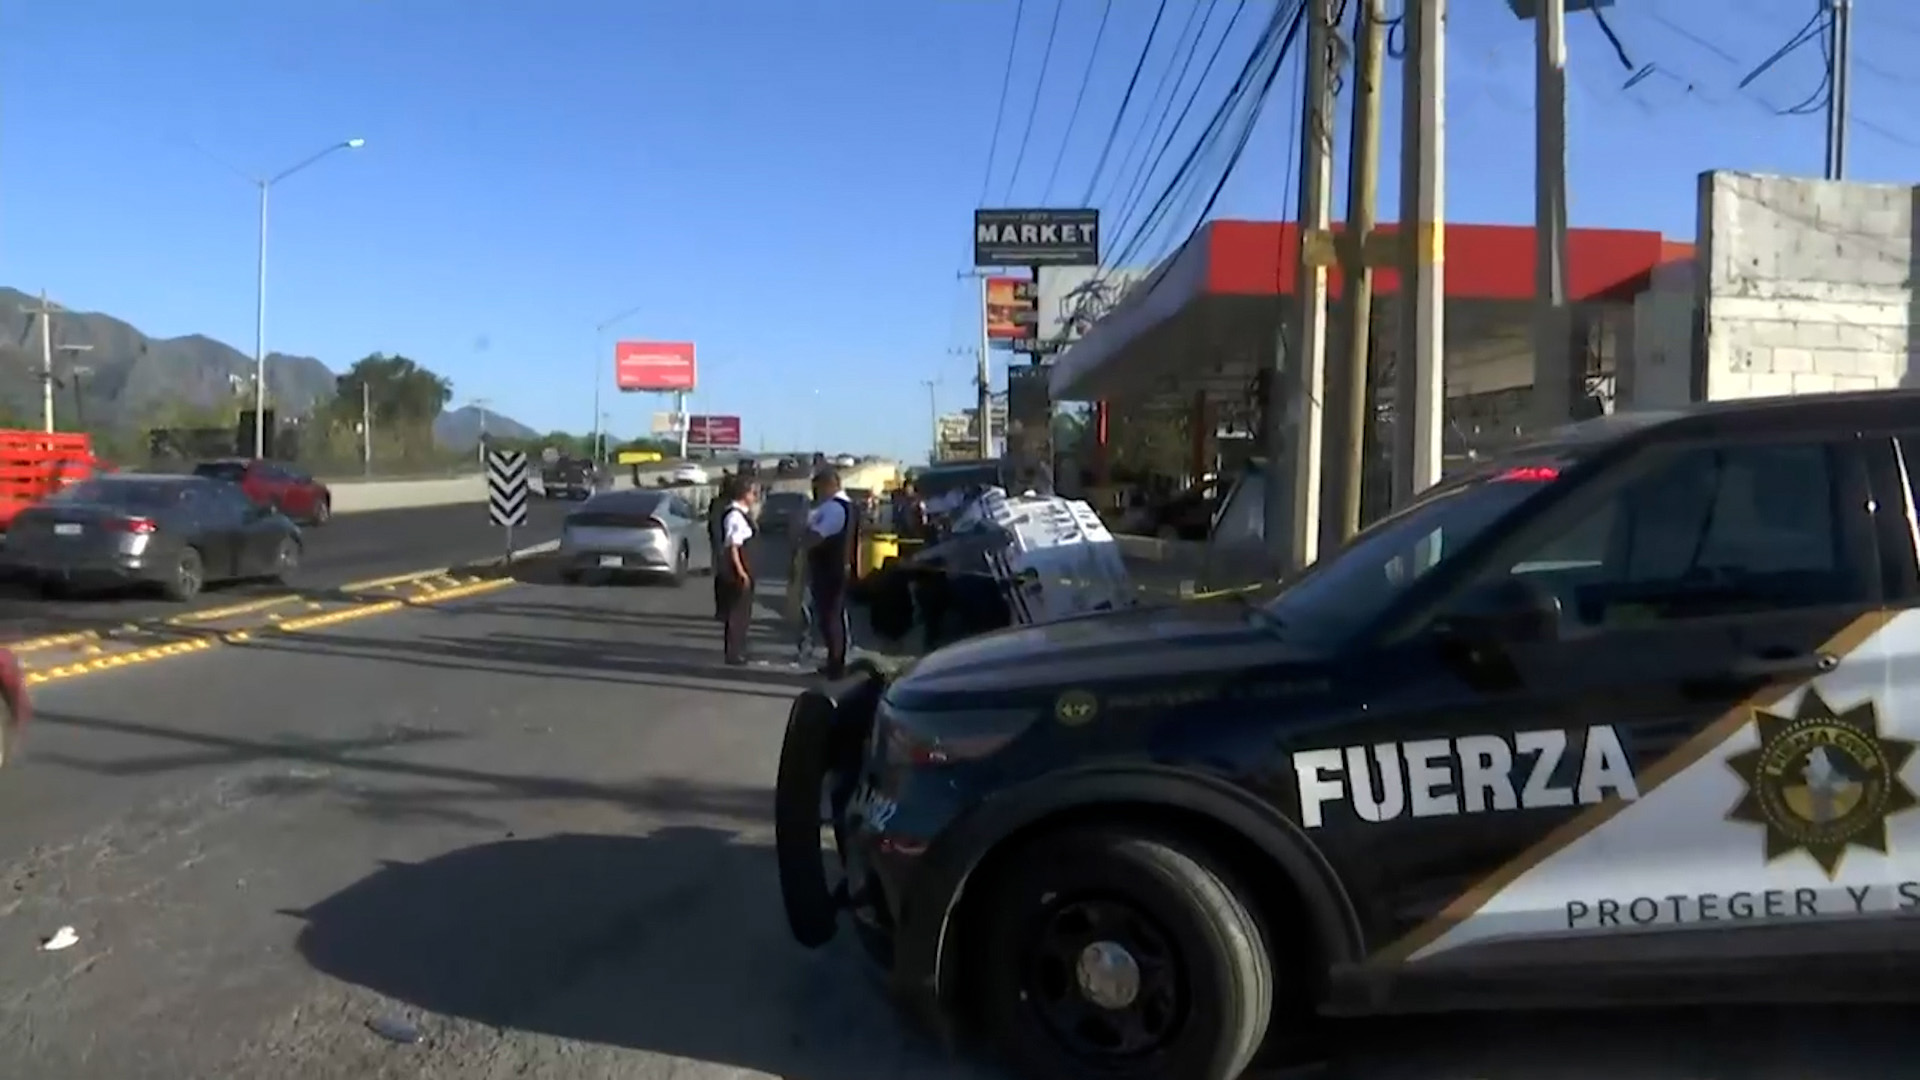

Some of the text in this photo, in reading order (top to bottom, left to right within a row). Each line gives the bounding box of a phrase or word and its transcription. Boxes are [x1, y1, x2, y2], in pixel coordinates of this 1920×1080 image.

[978, 223, 1096, 243] MARKET
[1293, 724, 1640, 829] FUERZA
[1566, 887, 1818, 929] PROTEGER
[1847, 885, 1871, 912] Y
